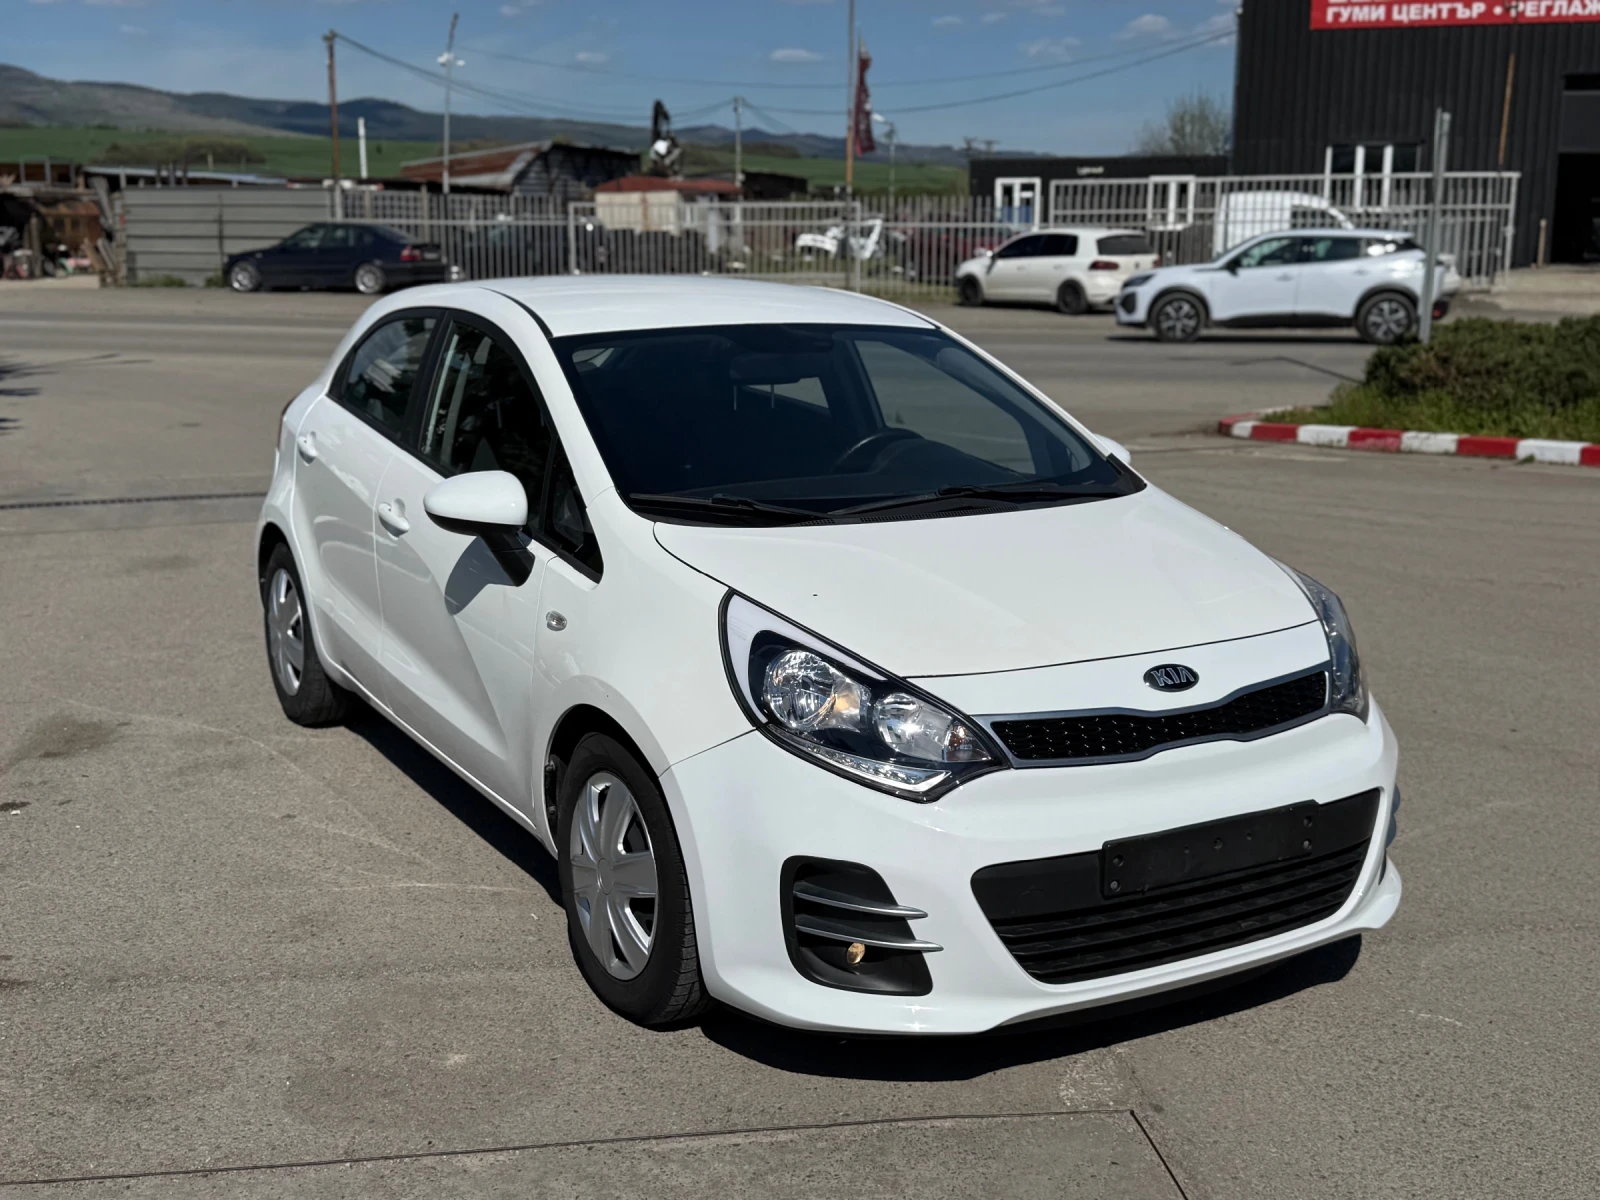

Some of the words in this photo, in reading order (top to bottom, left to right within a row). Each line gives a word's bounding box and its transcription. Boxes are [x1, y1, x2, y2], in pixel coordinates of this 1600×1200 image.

[1325, 5, 1386, 23] ГУМИ
[1392, 2, 1486, 24] ЦЕНТЪР
[1150, 666, 1195, 687] KIA
